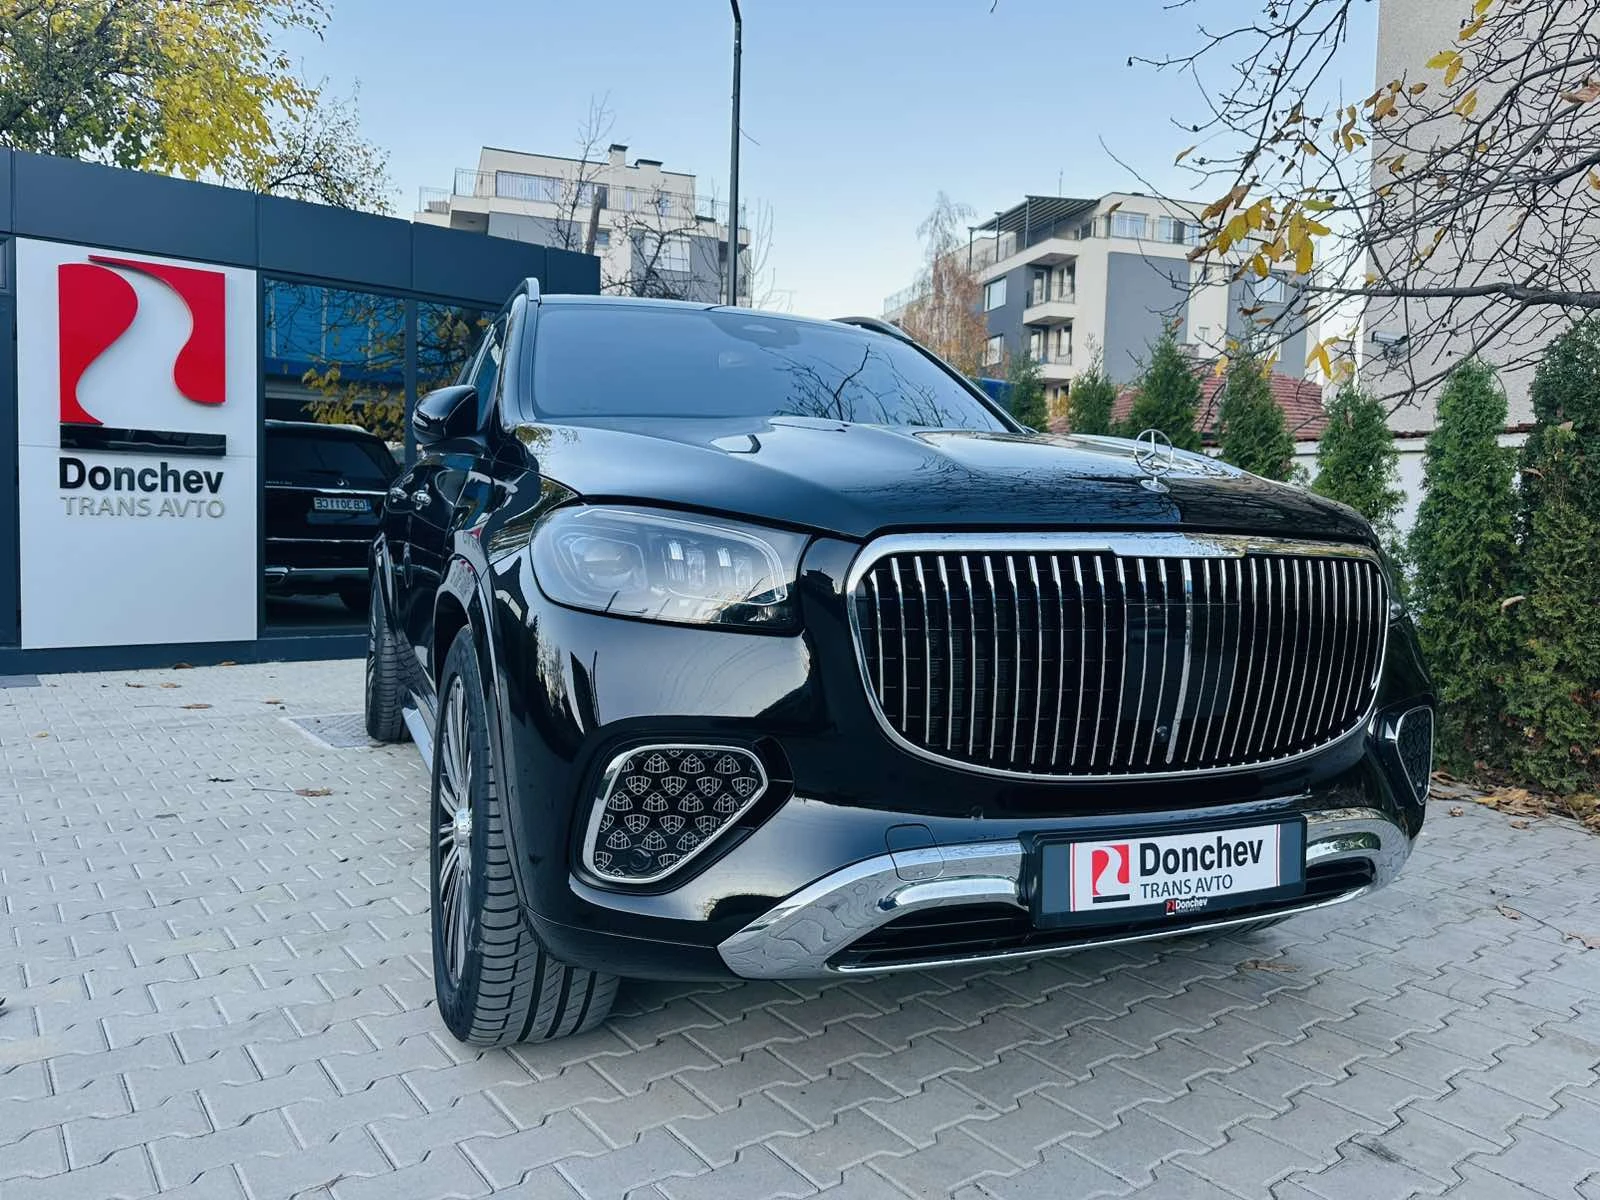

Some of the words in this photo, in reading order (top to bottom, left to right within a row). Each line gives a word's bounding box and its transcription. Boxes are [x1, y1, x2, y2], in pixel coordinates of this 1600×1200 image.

[59, 457, 224, 494] Donchev
[60, 497, 151, 517] TRANS
[157, 499, 225, 519] AVTO
[1139, 835, 1264, 877] Donchev
[1140, 878, 1192, 899] TRANS
[1195, 874, 1233, 894] AVTO
[1175, 897, 1208, 910] Donchev
